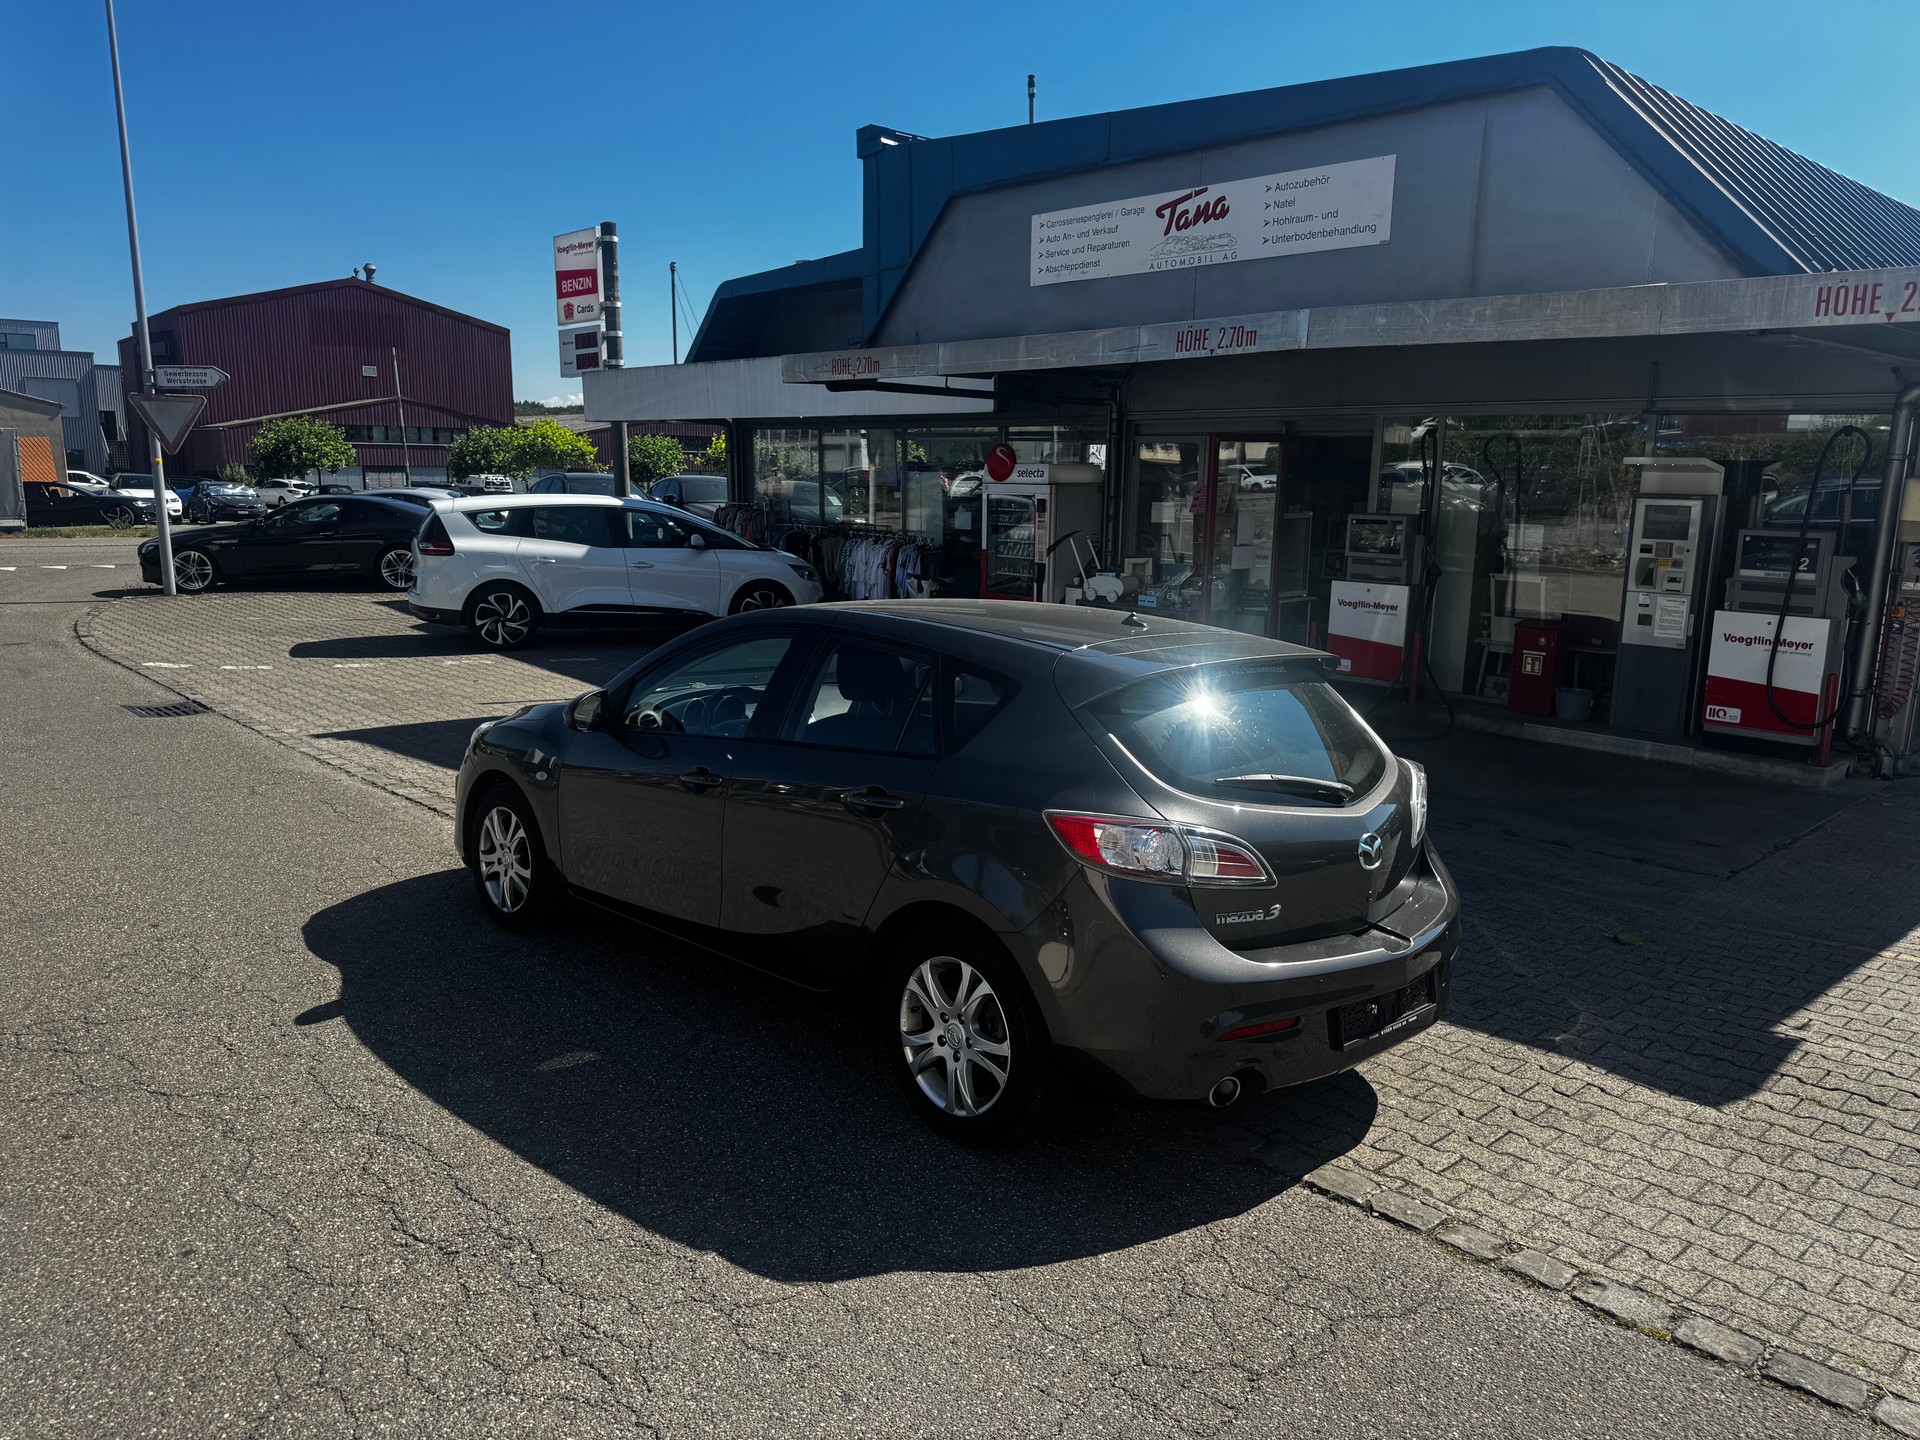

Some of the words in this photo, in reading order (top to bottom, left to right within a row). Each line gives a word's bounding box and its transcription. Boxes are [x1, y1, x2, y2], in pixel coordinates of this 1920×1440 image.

[1274, 175, 1331, 192] Autozubehör
[1155, 186, 1230, 237] Tana
[1273, 197, 1296, 210] Natel
[1046, 209, 1114, 228] Carrosseriespenglerei
[1120, 206, 1145, 217] Garage
[1272, 214, 1318, 227] Hohlraum-
[1321, 209, 1339, 220] und
[1046, 235, 1061, 243] Auto
[1077, 230, 1090, 239] und
[1092, 225, 1119, 236] Verkauf
[1271, 223, 1377, 245] Unterbodenbehandlung
[1045, 247, 1070, 259] Service
[1072, 245, 1085, 255] und
[1086, 240, 1131, 253] Reparaturen
[1045, 259, 1101, 274] Abschleppdienst
[1149, 254, 1214, 270] AUTOMOBIL
[1222, 251, 1238, 260] AG
[561, 276, 593, 293] BENZIN
[1815, 278, 1884, 317] HÖHE
[576, 304, 595, 314] Cards
[1175, 325, 1210, 353] HÖHE
[831, 354, 852, 376] HÖHE
[1016, 468, 1045, 478] selecta
[1797, 557, 1810, 571] 2
[1723, 632, 1814, 650] Voegtlin-Meyer
